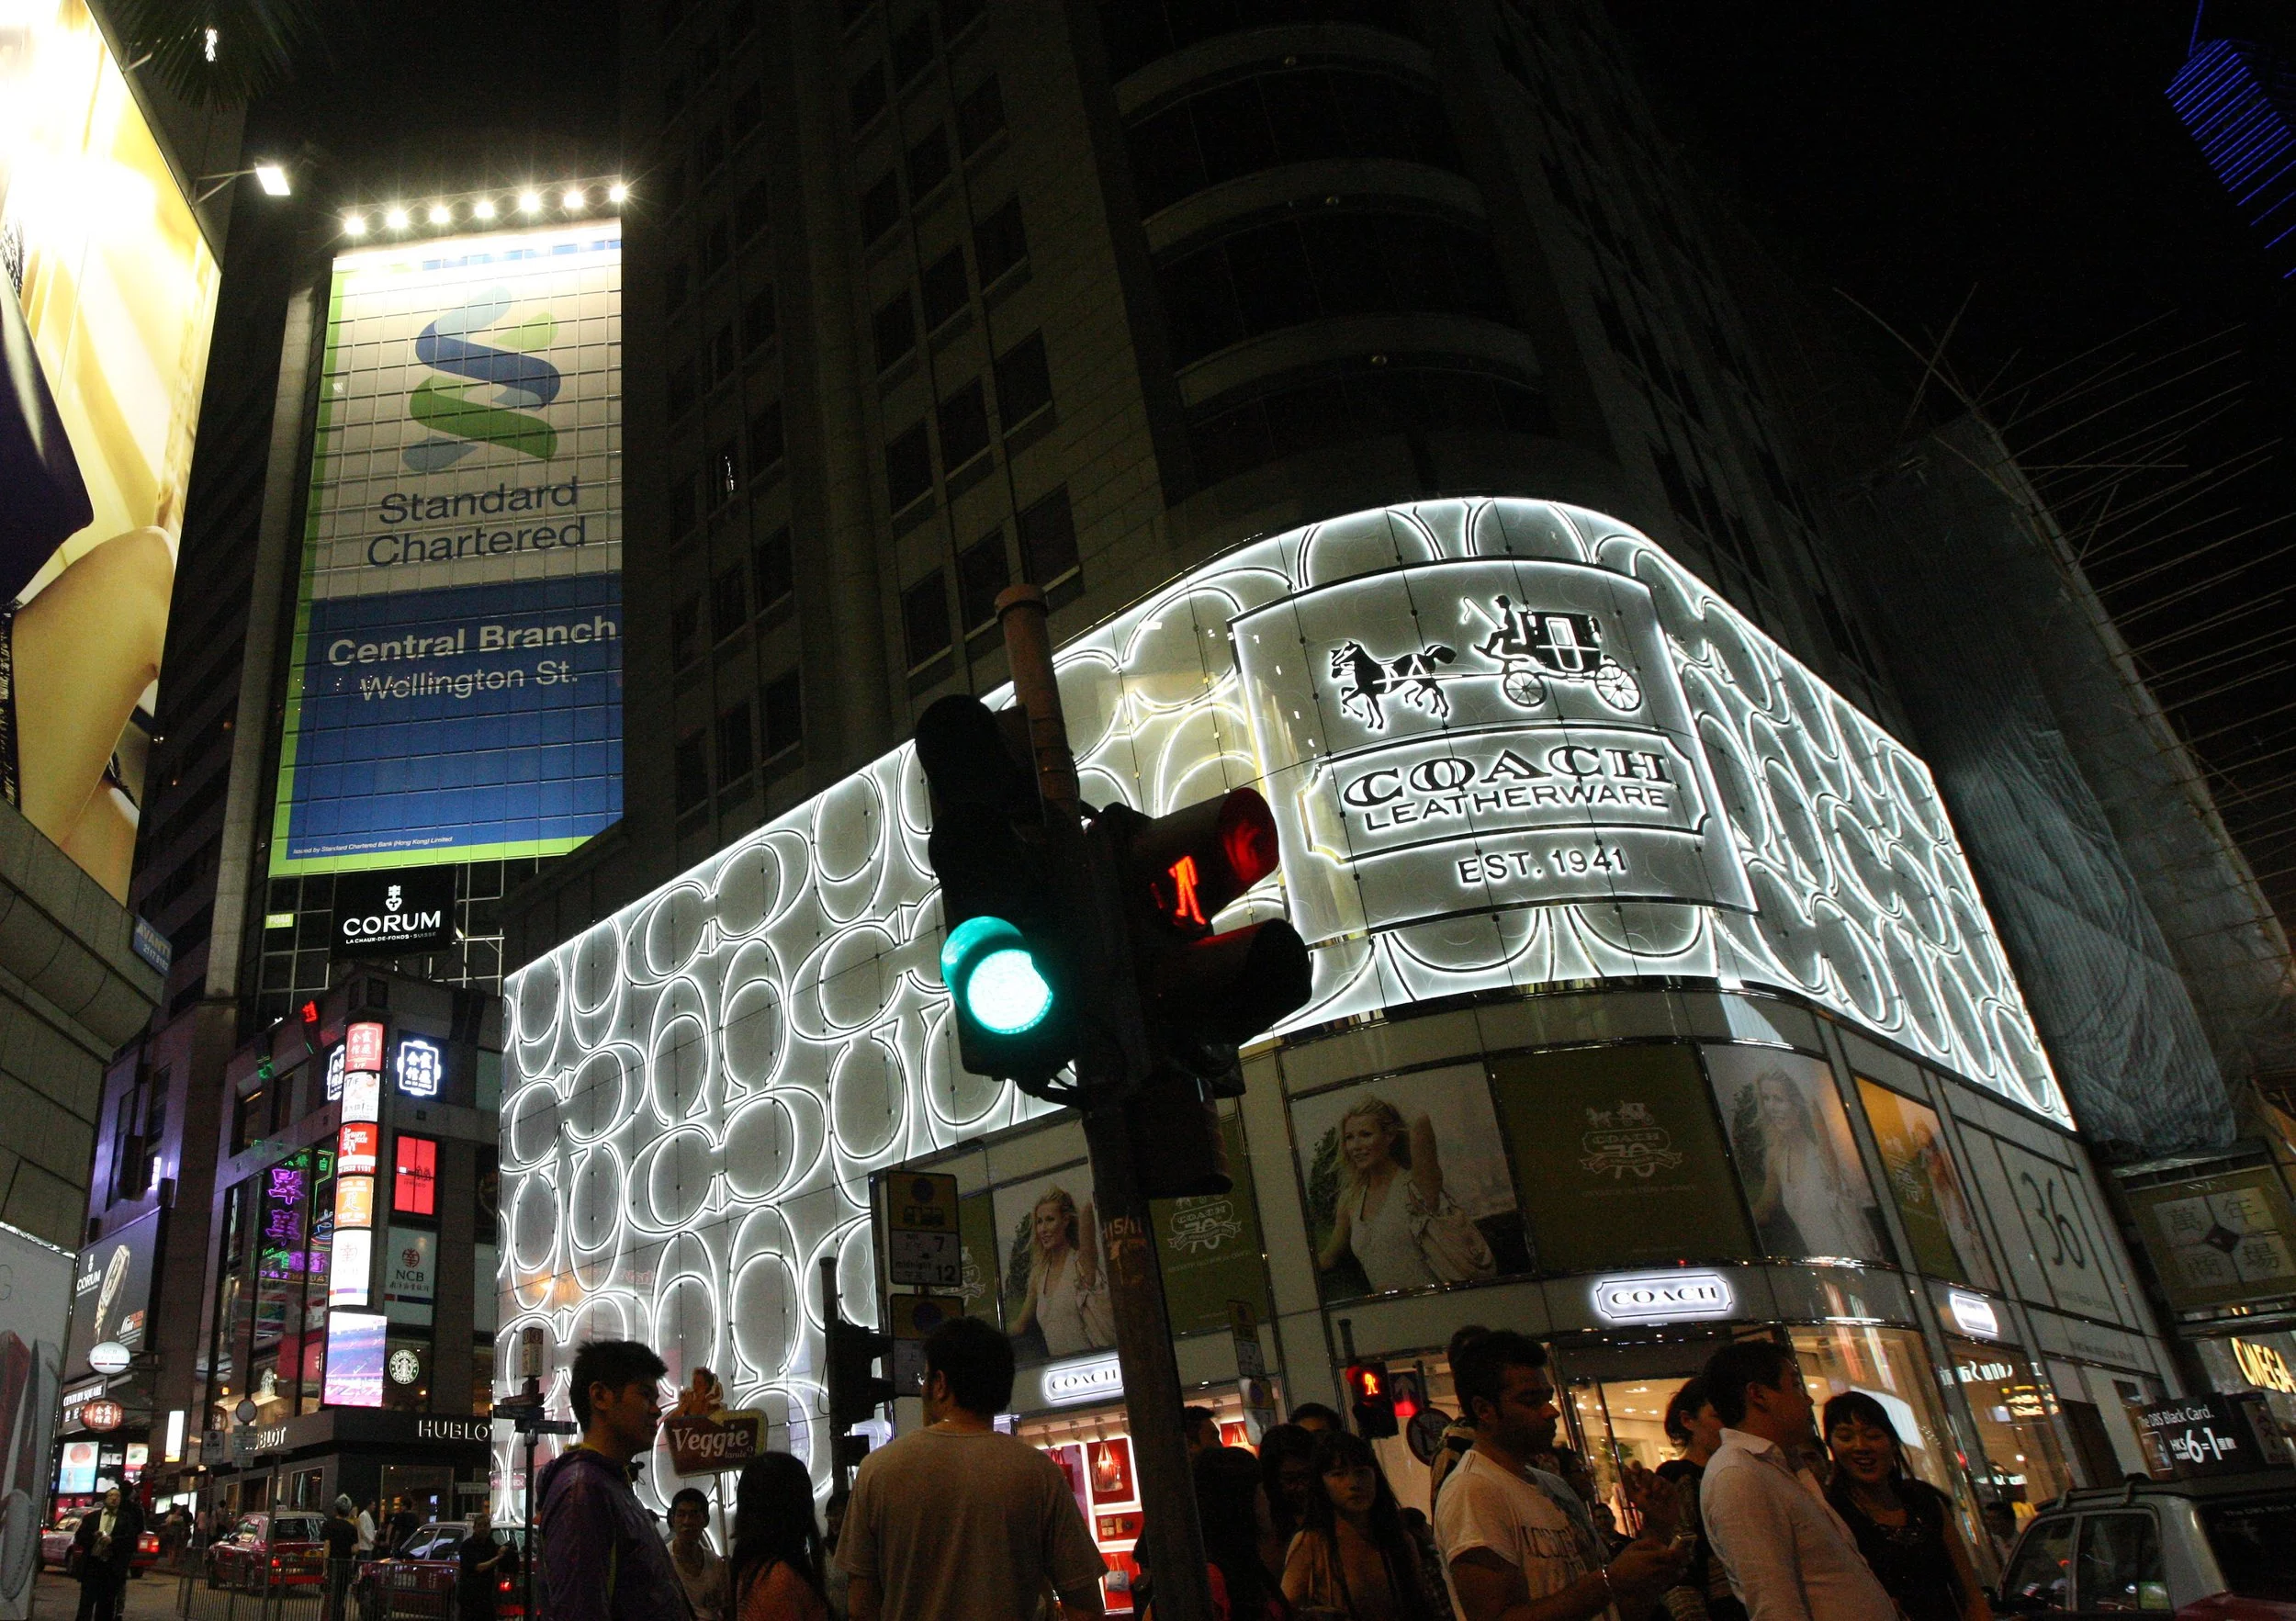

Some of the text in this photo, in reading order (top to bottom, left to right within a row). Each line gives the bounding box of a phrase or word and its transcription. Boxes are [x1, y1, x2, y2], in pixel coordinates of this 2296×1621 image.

[378, 476, 578, 524] Standard
[367, 516, 586, 568] Chartered
[328, 615, 616, 667] Central Branch
[360, 660, 578, 702] Wellington St.
[1343, 745, 1671, 807] COACH
[1364, 785, 1670, 832] LEATHERWARE
[293, 847, 312, 855] Issued
[321, 844, 348, 852] Standard
[348, 841, 377, 850] Chartered
[377, 840, 393, 849] Bank
[393, 839, 411, 848] (Hong
[411, 838, 430, 846] Kong)
[430, 836, 453, 844] Limited
[1458, 848, 1627, 884] EST. 1941
[343, 910, 441, 937] CORUM
[1176, 1205, 1227, 1224] COACH
[2020, 1171, 2085, 1269] 36
[76, 1269, 102, 1292] CORUM
[396, 1269, 424, 1283] NCB
[936, 1265, 956, 1281] 12
[1611, 1285, 1719, 1305] COACH
[391, 1350, 418, 1368] STARBUCKS
[2230, 1337, 2296, 1394] OMEGA
[393, 1372, 415, 1384] COFFEE
[1052, 1369, 1116, 1390] COACH
[2161, 1407, 2187, 1424] Black
[2186, 1404, 2215, 1421] Card.
[418, 1419, 490, 1442] HUBLO
[671, 1424, 749, 1458] Veggie
